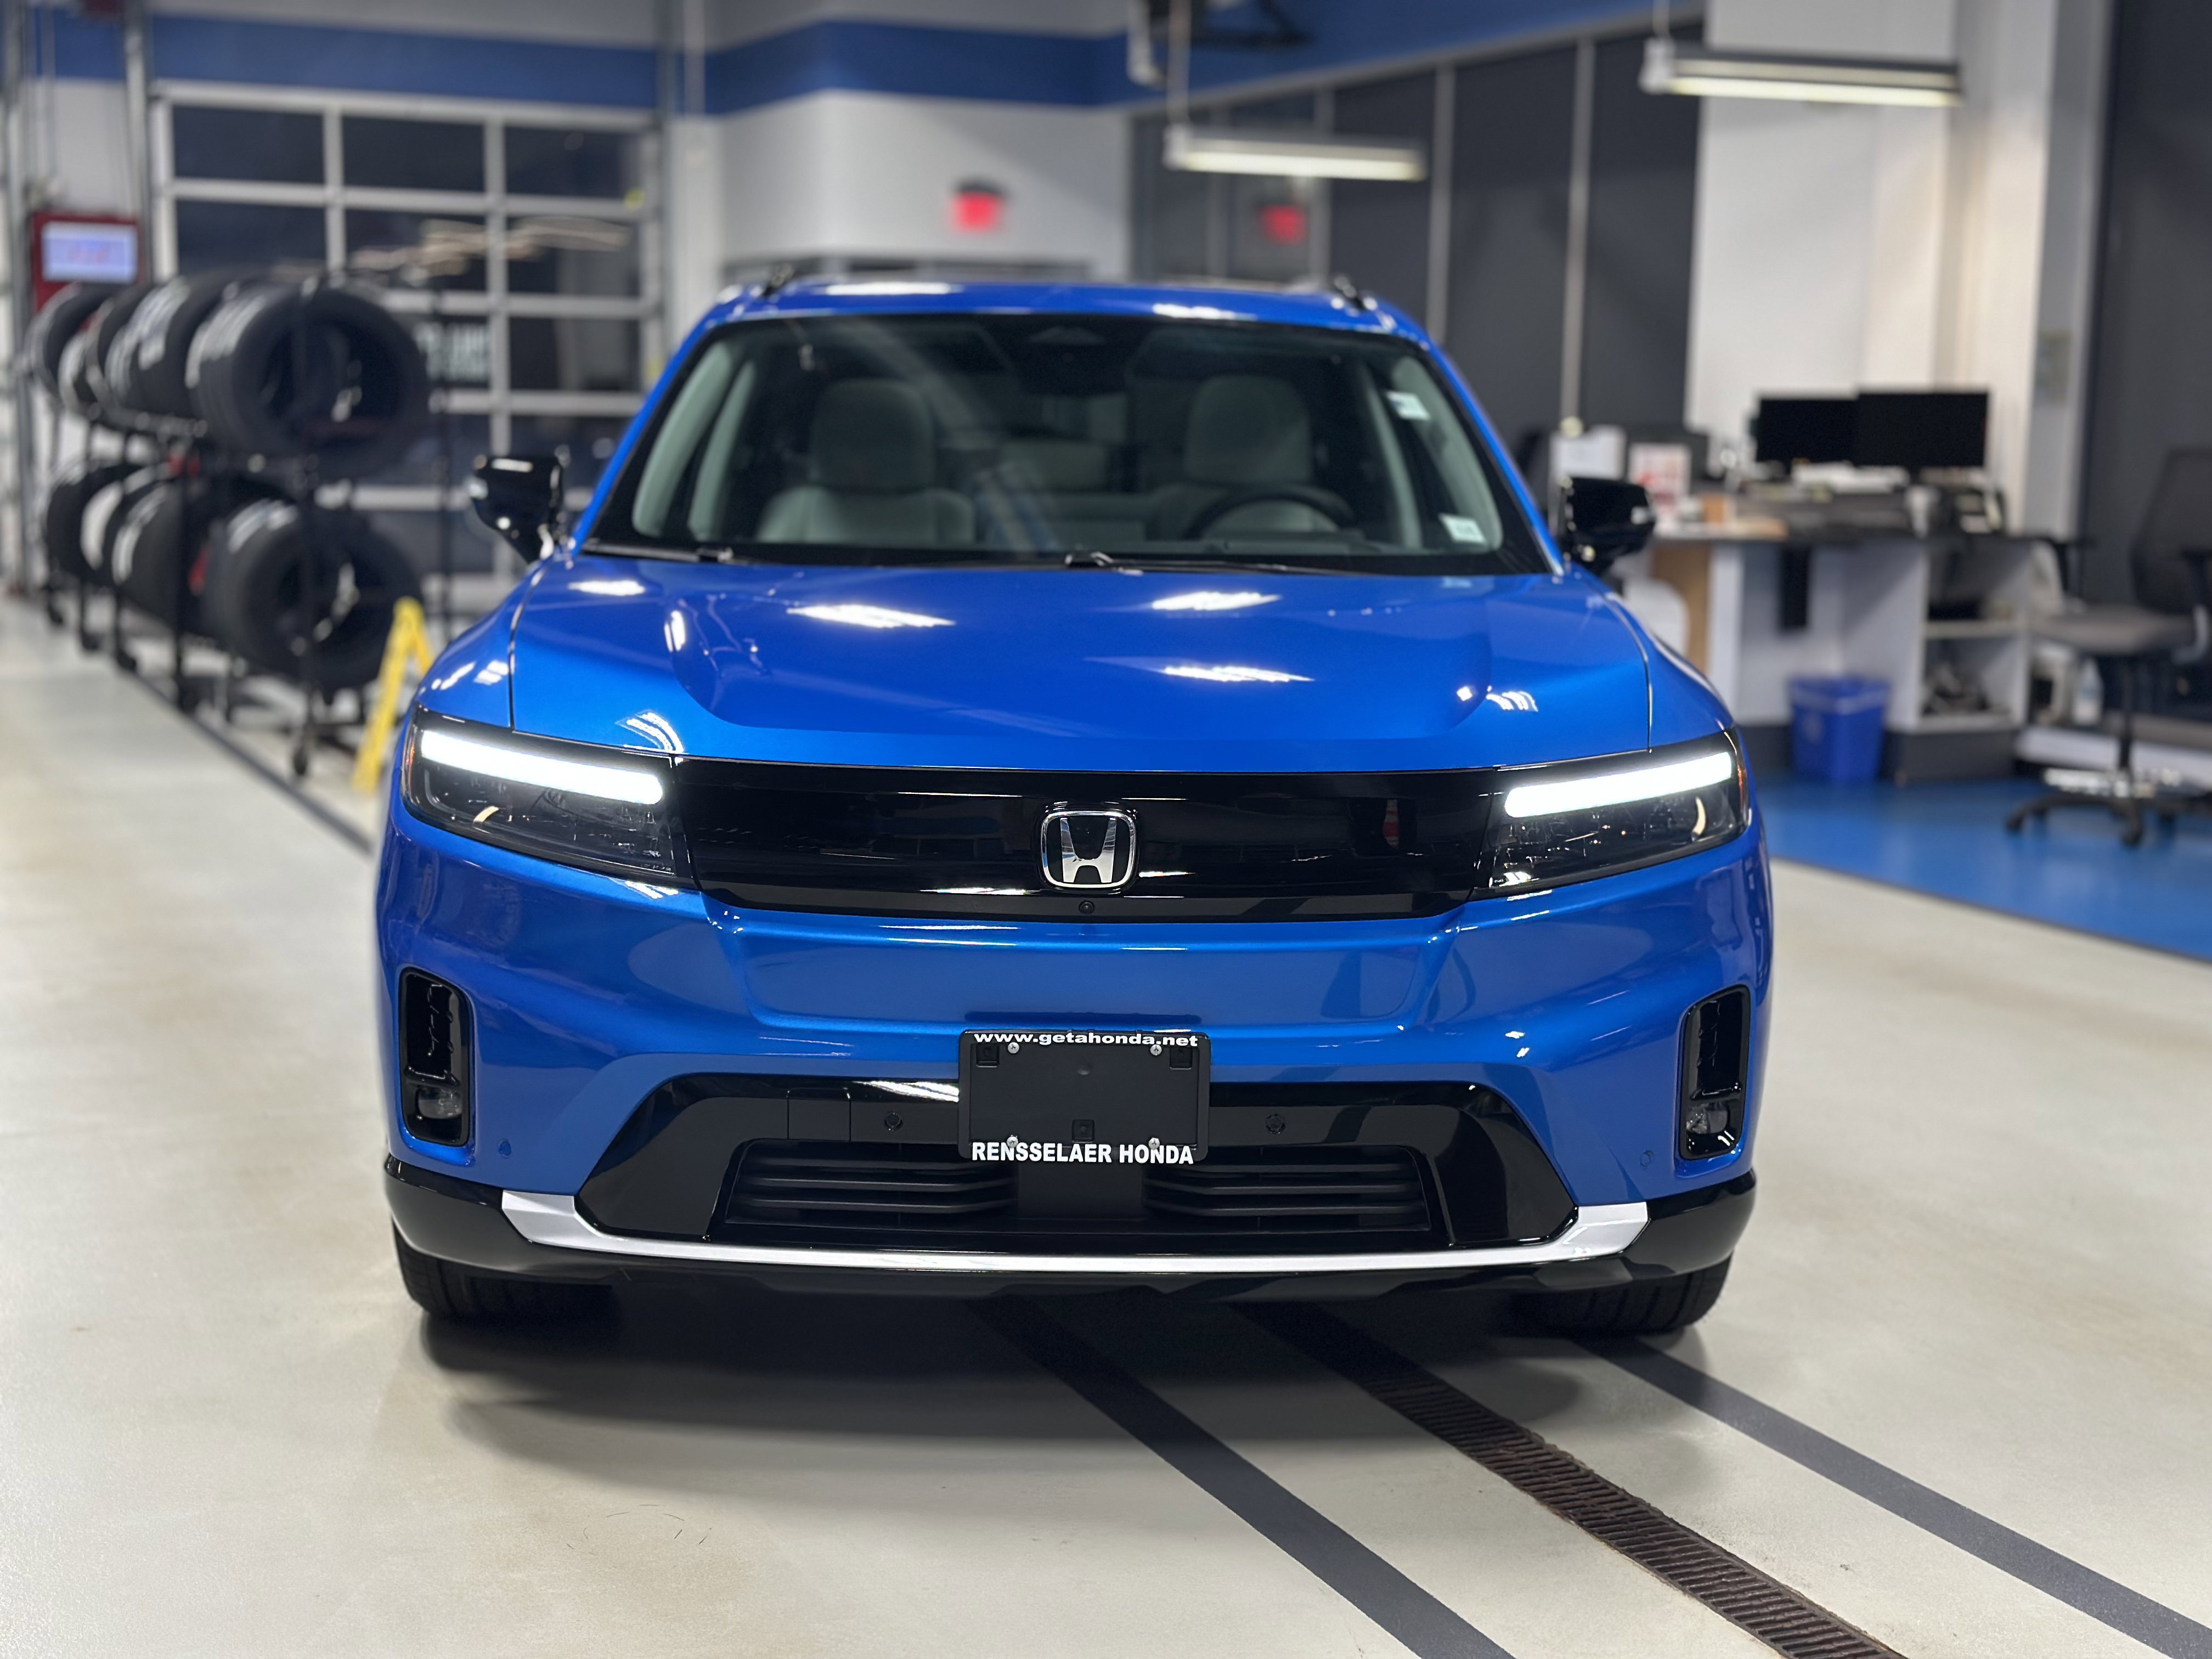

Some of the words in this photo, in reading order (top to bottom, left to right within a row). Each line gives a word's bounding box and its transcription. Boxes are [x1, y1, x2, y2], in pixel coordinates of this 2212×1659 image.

[973, 1032, 1198, 1046] www.getahonda.net
[972, 1142, 1112, 1163] RENSSELAER
[1119, 1144, 1194, 1164] HONDA
